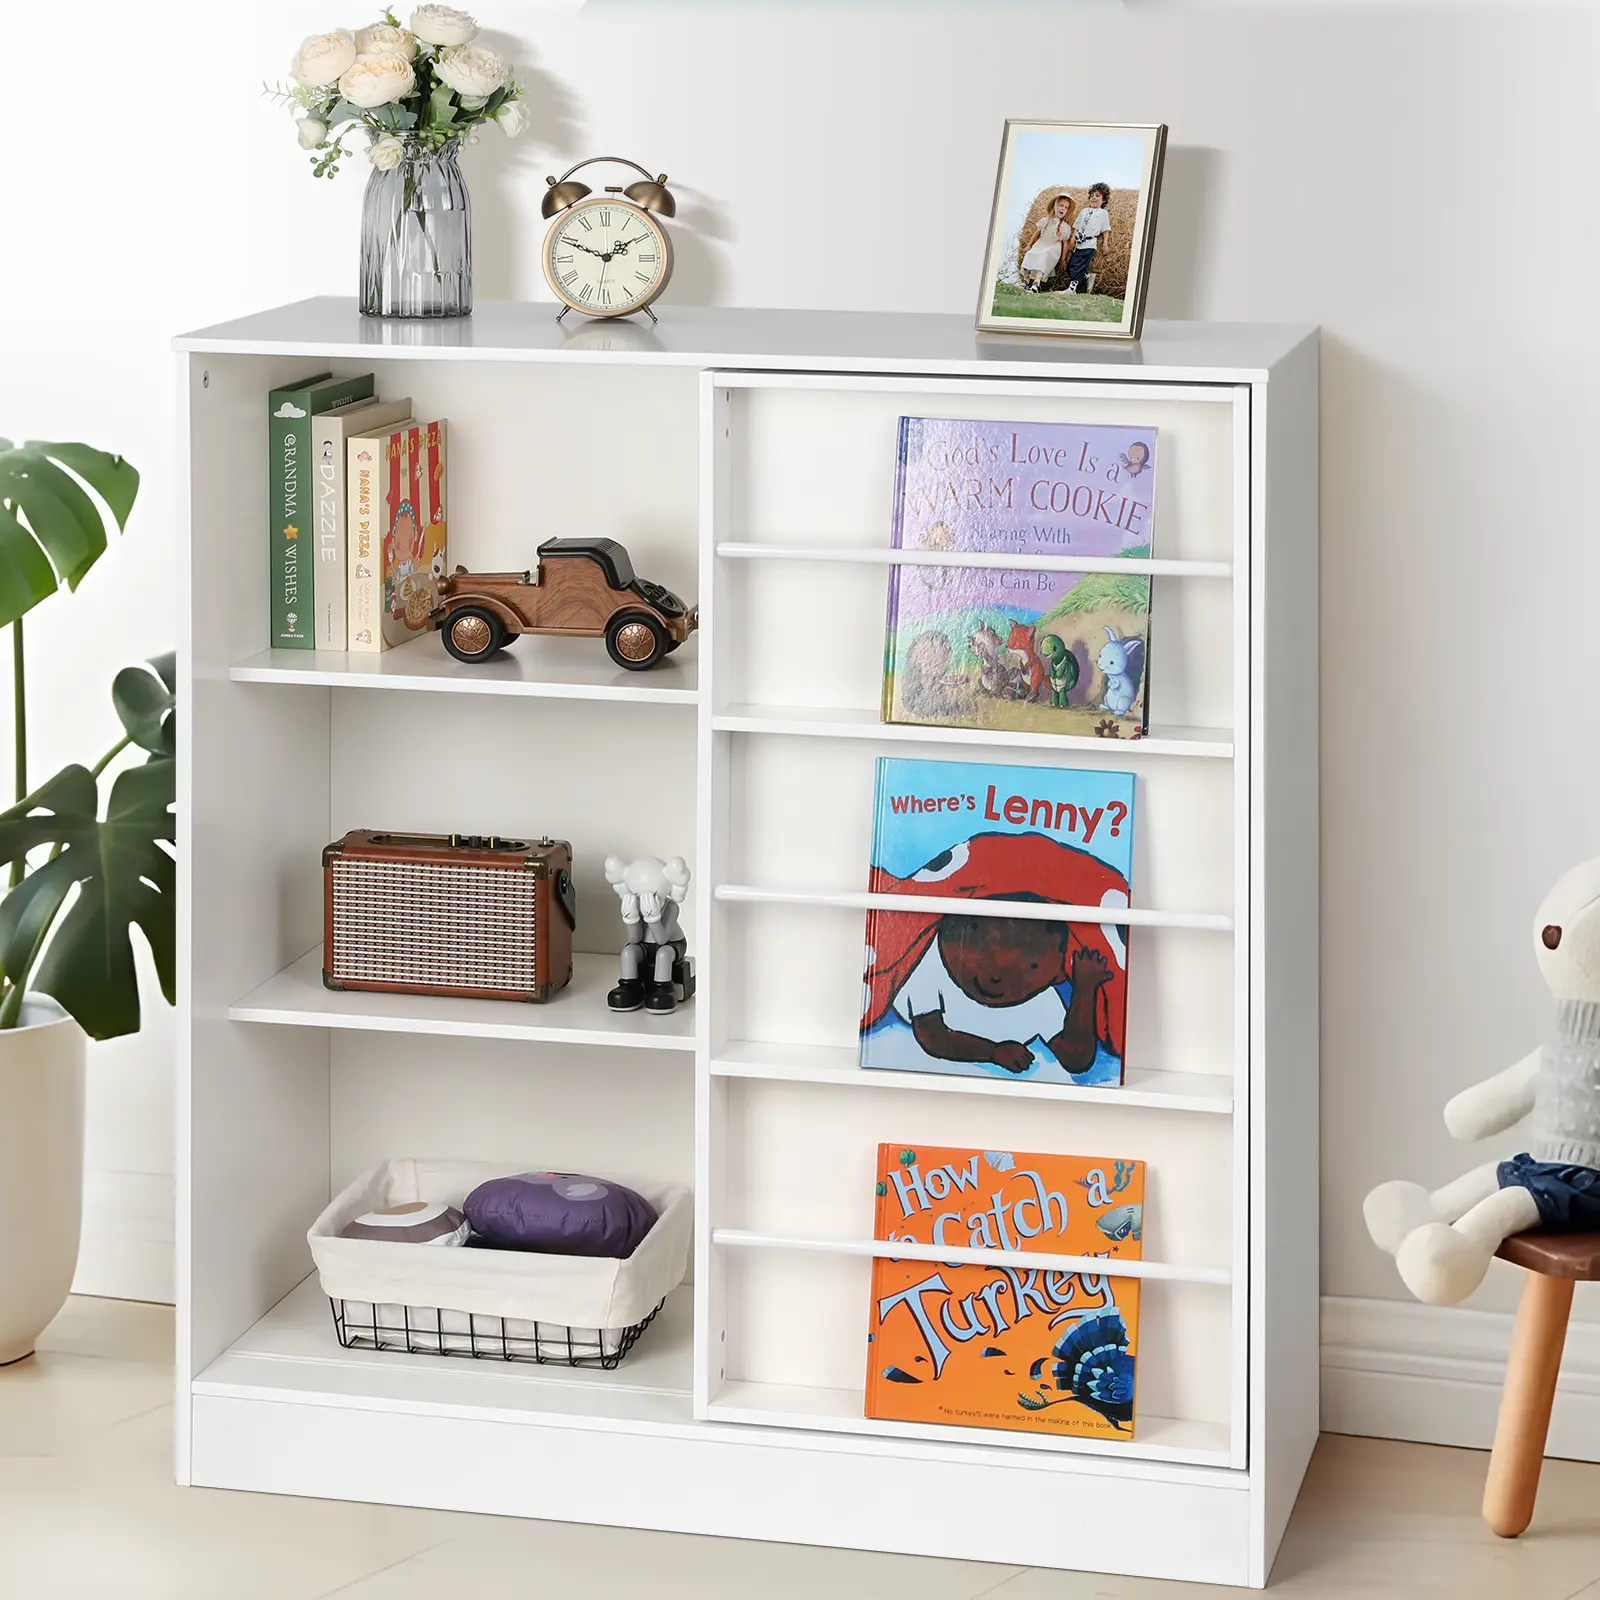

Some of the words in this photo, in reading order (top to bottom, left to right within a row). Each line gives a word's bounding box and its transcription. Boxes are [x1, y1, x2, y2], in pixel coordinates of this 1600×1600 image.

[599, 211, 611, 227] XII
[639, 254, 655, 263] III
[283, 433, 297, 519] GRANDMA
[926, 437, 999, 471] God's
[1010, 432, 1067, 468] Love
[1077, 441, 1099, 475] Is
[1106, 463, 1120, 483] a
[319, 463, 337, 562] DAZZLE
[358, 469, 371, 516] NANA'S
[905, 477, 1014, 519] WARM
[1030, 479, 1148, 536] COOKIE
[358, 520, 370, 559] PIZZA
[1032, 525, 1071, 544] With
[283, 543, 298, 604] WISHES
[1000, 573, 1031, 591] Can
[1036, 573, 1056, 592] Be
[890, 793, 976, 814] Where's
[983, 784, 1128, 843] Lenny?
[887, 1155, 980, 1220] How
[932, 1170, 1069, 1268] Catch
[1085, 1168, 1113, 1208] a
[1001, 1413, 1026, 1421] harmed
[1048, 1418, 1070, 1426] making
[1082, 1420, 1094, 1428] this
[1095, 1421, 1112, 1429] book
